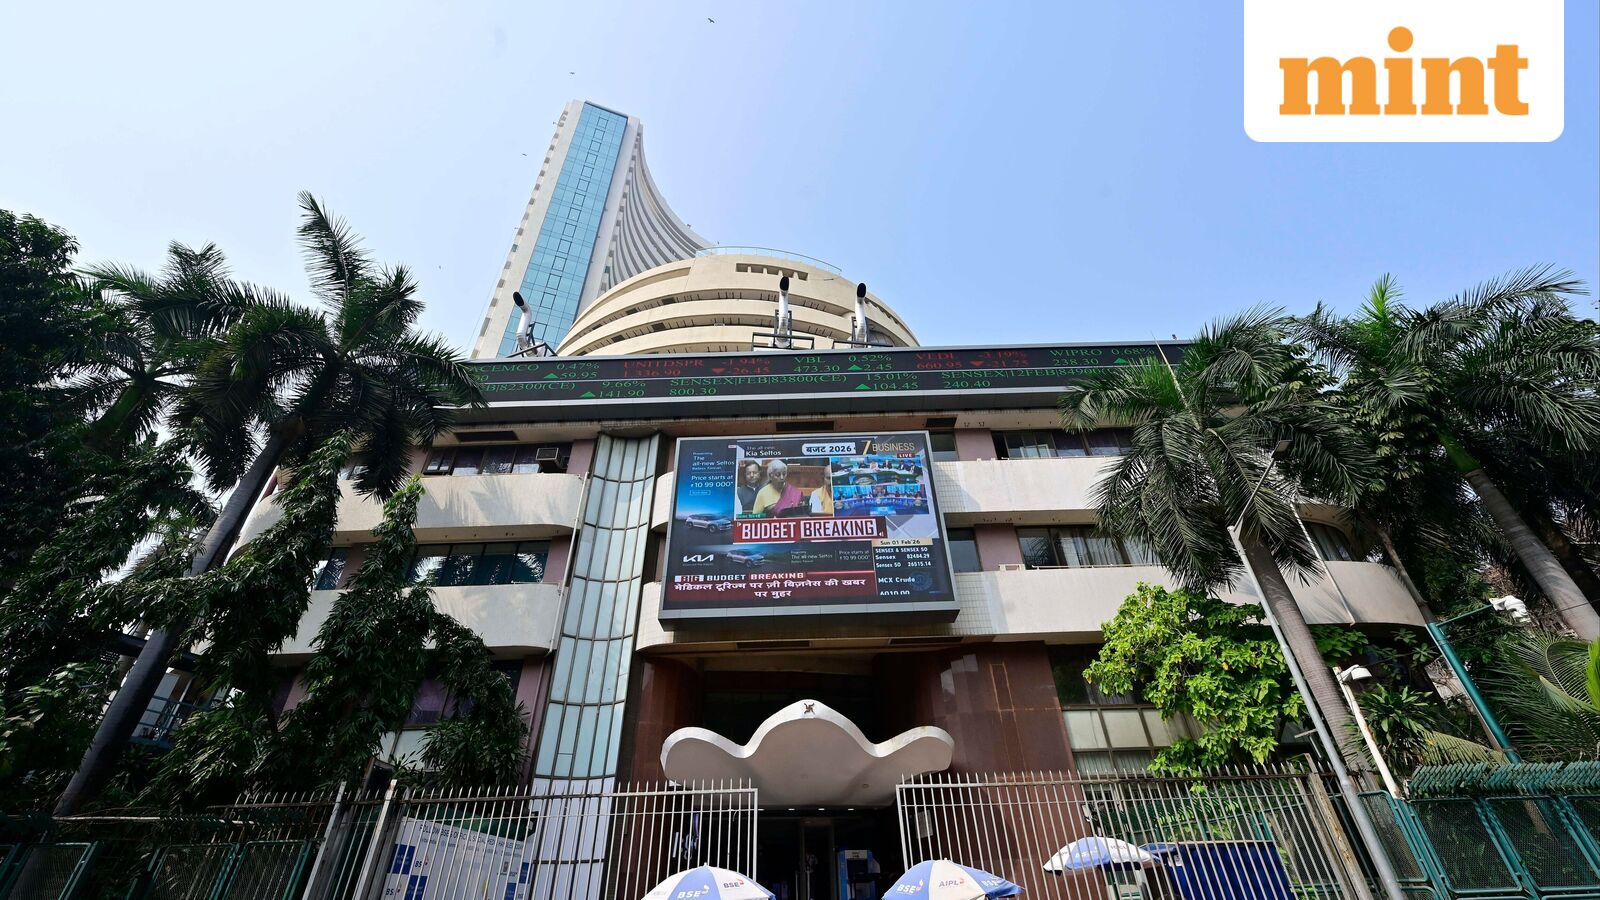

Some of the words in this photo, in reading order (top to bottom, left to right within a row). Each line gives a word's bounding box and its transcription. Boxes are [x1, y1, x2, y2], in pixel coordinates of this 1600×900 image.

[556, 362, 600, 370] 0.47%
[794, 356, 826, 364] VBL
[848, 354, 892, 362] 0.52%
[1050, 349, 1103, 357] WIPRO
[1111, 347, 1155, 355] 0.68%
[560, 371, 598, 379] 59.95
[793, 365, 841, 373] 473.30
[863, 363, 893, 371] 2.45
[1052, 358, 1099, 366] 238.30
[602, 380, 646, 389] 9.66%
[866, 373, 918, 381] 15.01%
[599, 389, 645, 398] 141.90
[669, 387, 717, 396] 800.30
[873, 382, 919, 390] 104.45
[942, 380, 991, 389] 240.40
[805, 445, 827, 454] बजट
[872, 442, 915, 452] BUSINESS
[741, 521, 797, 540] BUDGET
[803, 520, 874, 537] BREAKING
[750, 572, 804, 580] BREAKING
[674, 582, 713, 591] मेडिकल
[824, 578, 838, 586] की
[896, 884, 916, 894] BSE
[938, 879, 959, 888] AIPL
[677, 889, 701, 899] BSE
